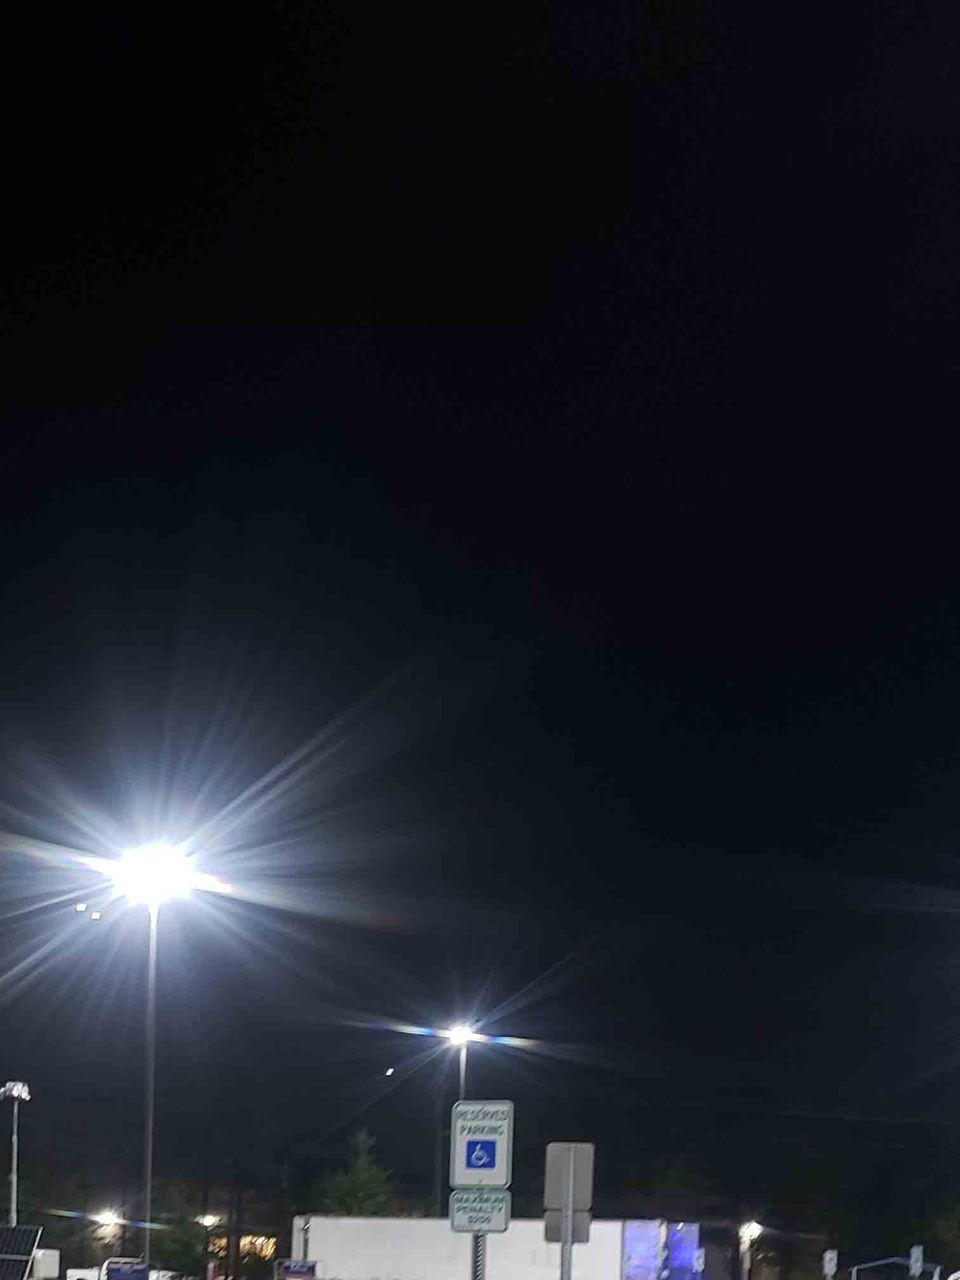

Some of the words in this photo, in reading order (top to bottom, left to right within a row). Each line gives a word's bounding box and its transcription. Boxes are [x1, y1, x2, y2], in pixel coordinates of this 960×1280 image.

[458, 1108, 508, 1121] RESERVED
[460, 1125, 503, 1136] PARKING
[456, 1204, 503, 1214] PENALTY
